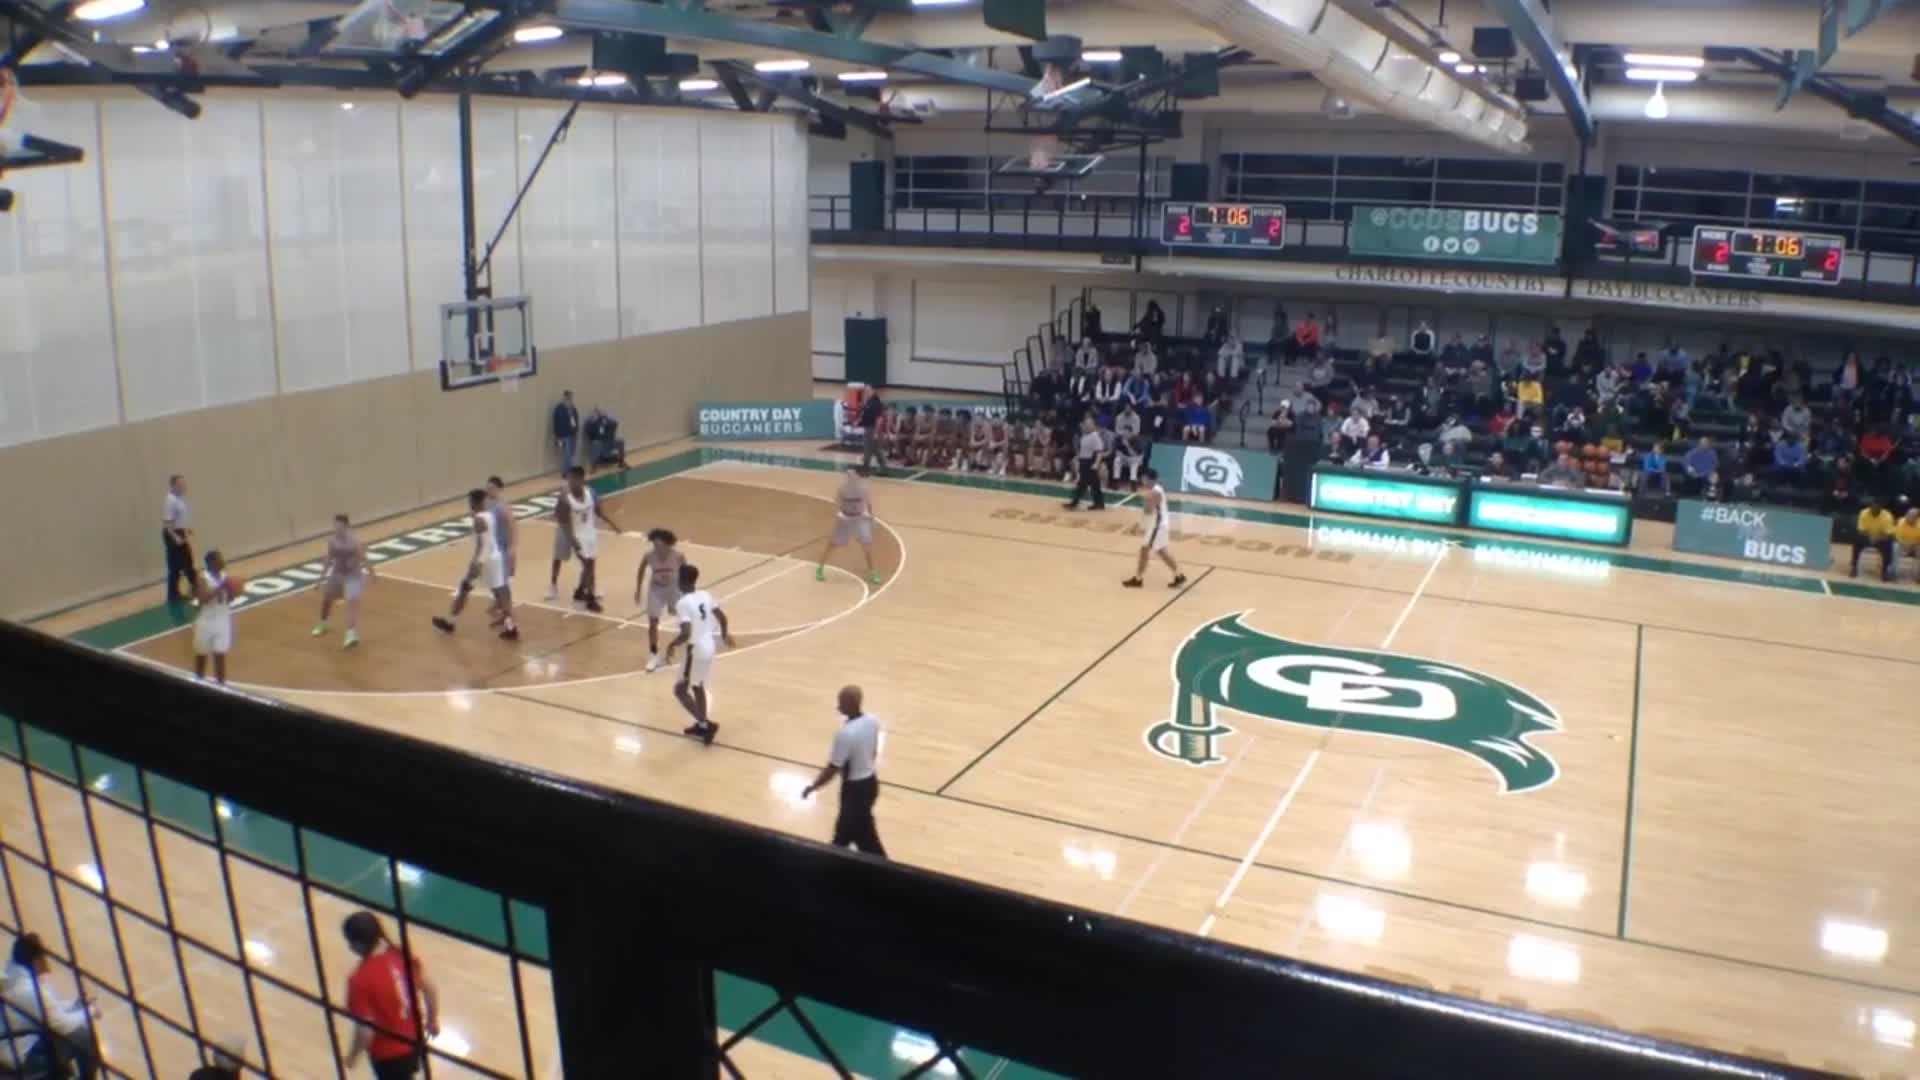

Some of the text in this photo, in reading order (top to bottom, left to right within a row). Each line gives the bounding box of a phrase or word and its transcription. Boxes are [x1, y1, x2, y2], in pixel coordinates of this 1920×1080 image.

[1176, 215, 1191, 234] 2
[1208, 206, 1249, 226] 7:06
[1268, 218, 1281, 237] 2
[1714, 242, 1730, 263] 2
[1752, 232, 1800, 257] 7:06
[1823, 250, 1841, 271] 2
[1334, 266, 1547, 293] CHARLOTTE COUNTRY
[699, 407, 802, 422] COUNTRY DAY
[699, 421, 803, 435] BUCCANEERS
[1701, 506, 1767, 529] #BACK
[1744, 539, 1808, 565] BUCS
